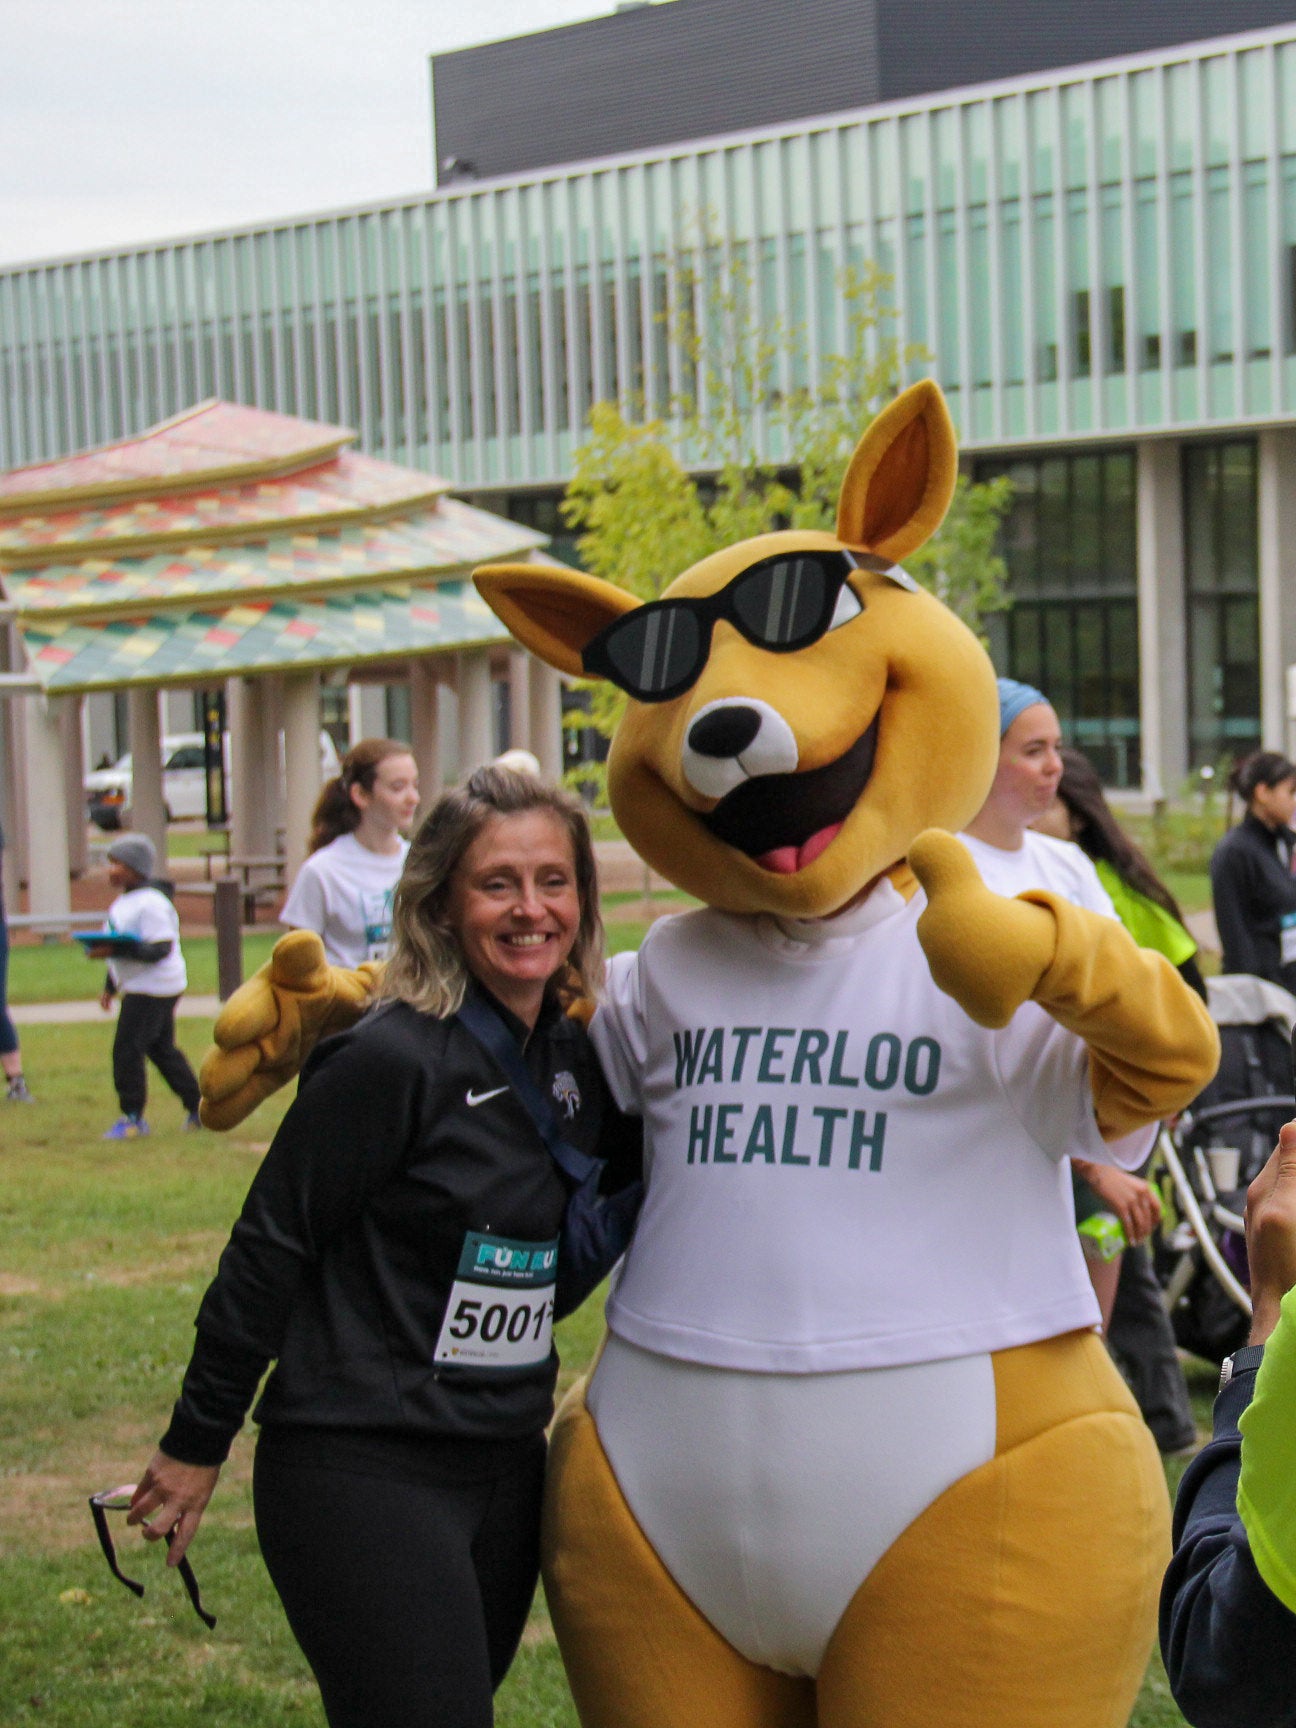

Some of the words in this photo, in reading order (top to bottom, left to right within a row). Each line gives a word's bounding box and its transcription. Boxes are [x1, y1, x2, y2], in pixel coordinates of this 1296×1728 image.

[673, 1026, 942, 1097] WATERLOO
[687, 1103, 888, 1172] HEALTH
[477, 1243, 530, 1269] FUN
